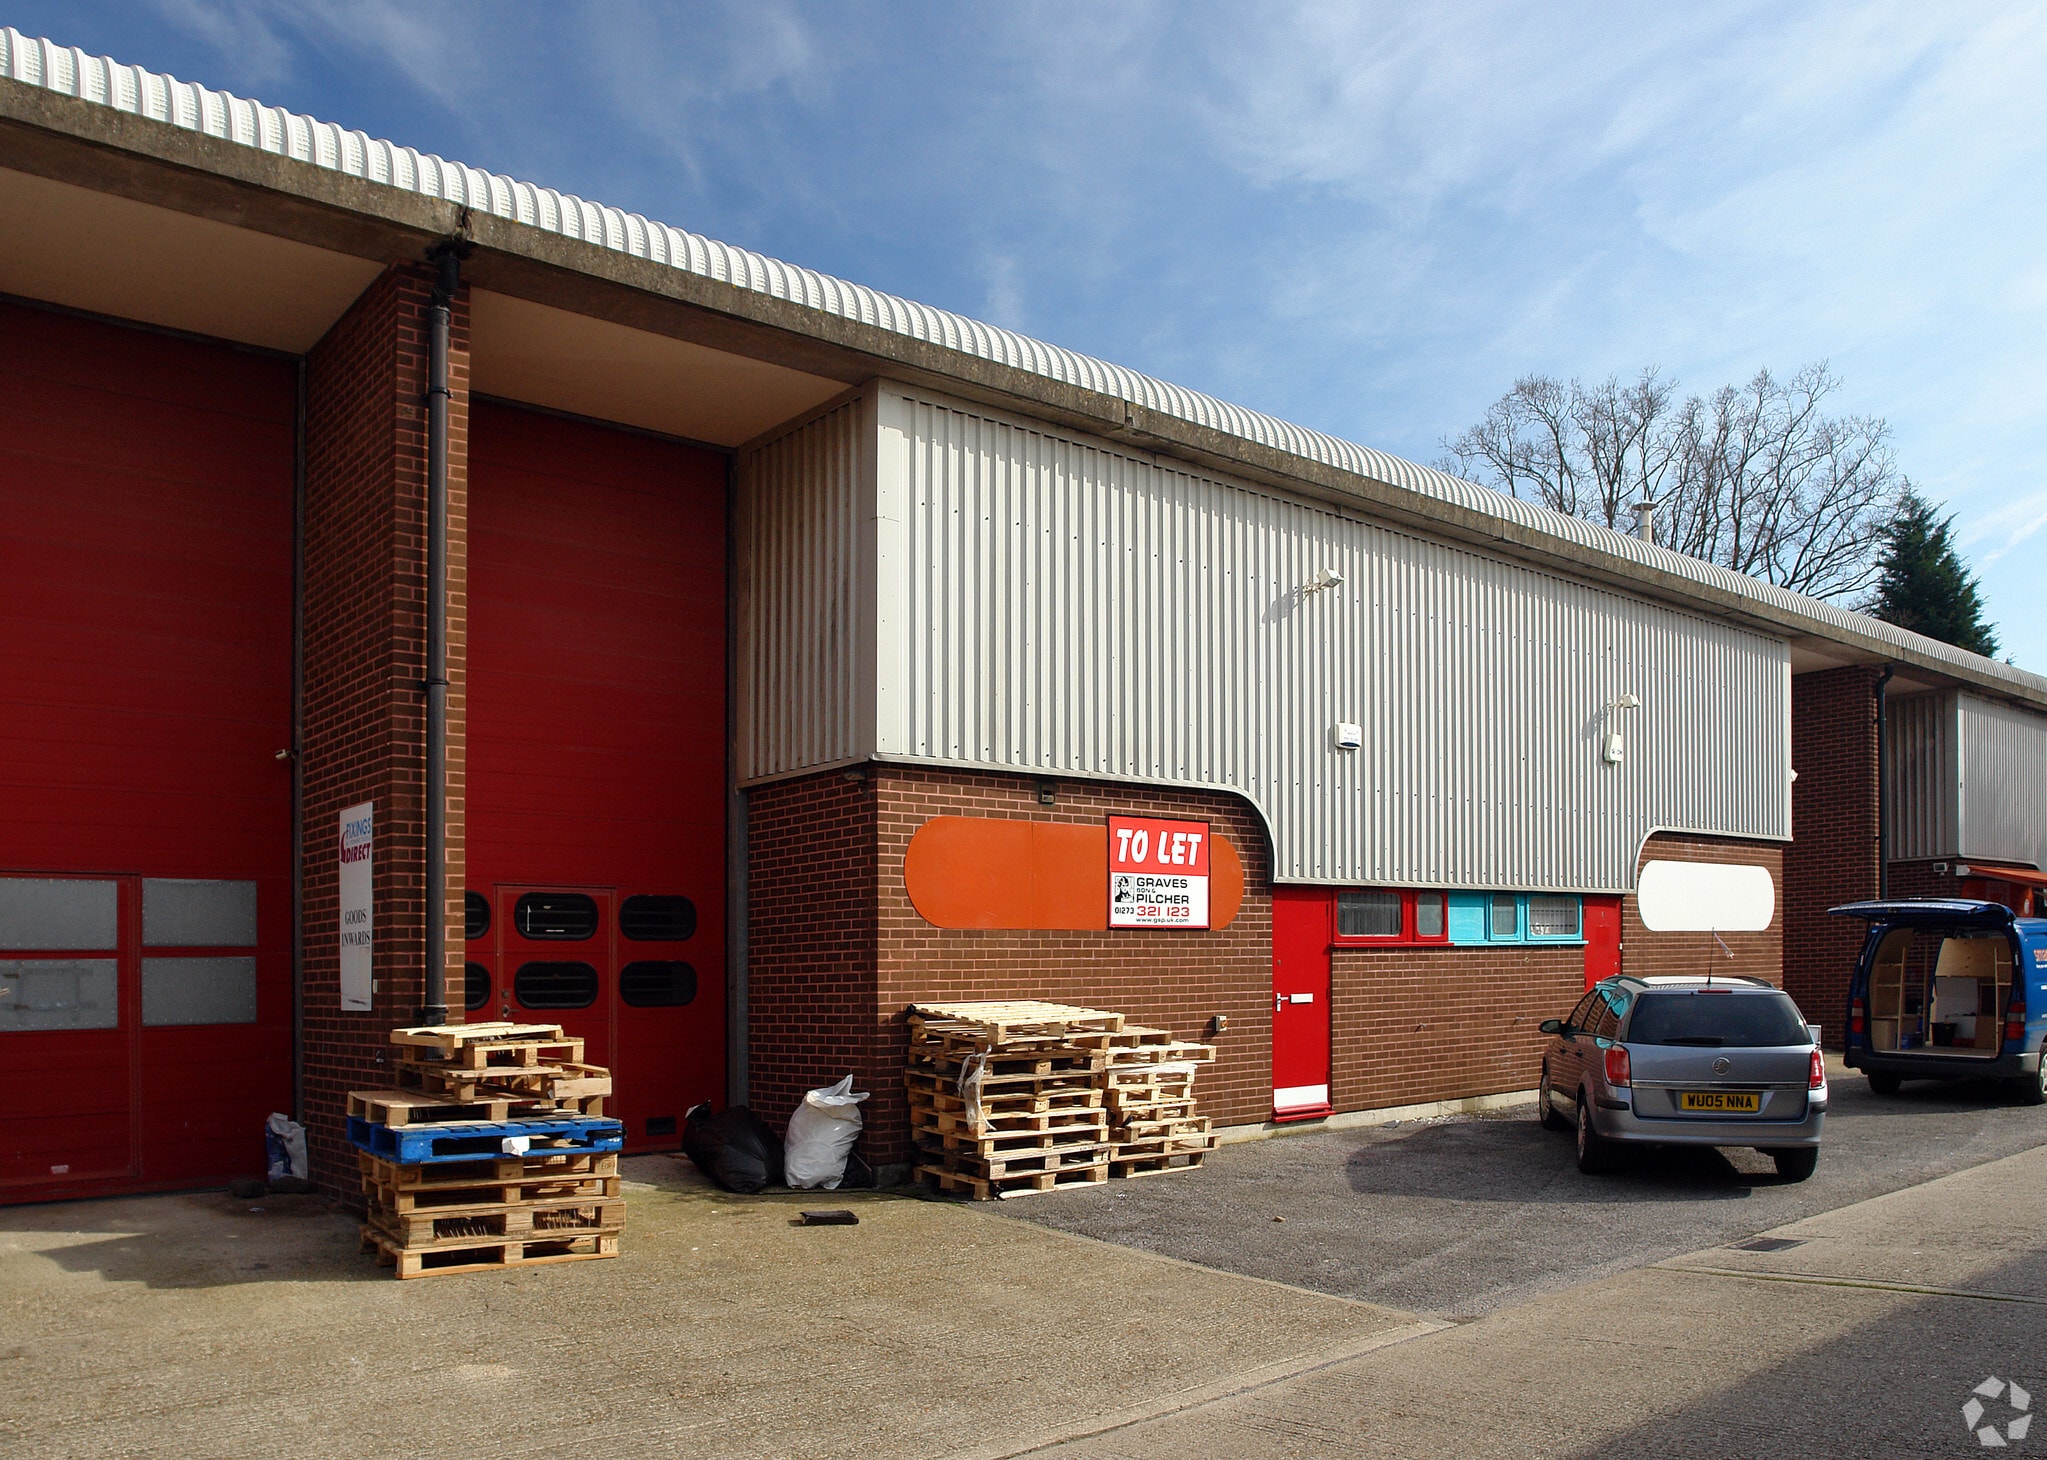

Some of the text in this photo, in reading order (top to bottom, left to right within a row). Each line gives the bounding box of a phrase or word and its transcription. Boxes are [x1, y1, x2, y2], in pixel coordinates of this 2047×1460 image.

[346, 817, 371, 839] FIXINGS
[345, 842, 370, 864] DIRECT
[1116, 828, 1203, 866] TO LET
[1136, 877, 1188, 888] GRAVES
[1136, 893, 1189, 904] PILCHER
[344, 909, 366, 925] GOODS
[1137, 905, 1161, 916] 321
[1167, 906, 1190, 917] 123
[341, 931, 370, 947] INWARDS
[1687, 1094, 1753, 1108] WU05 NNA
